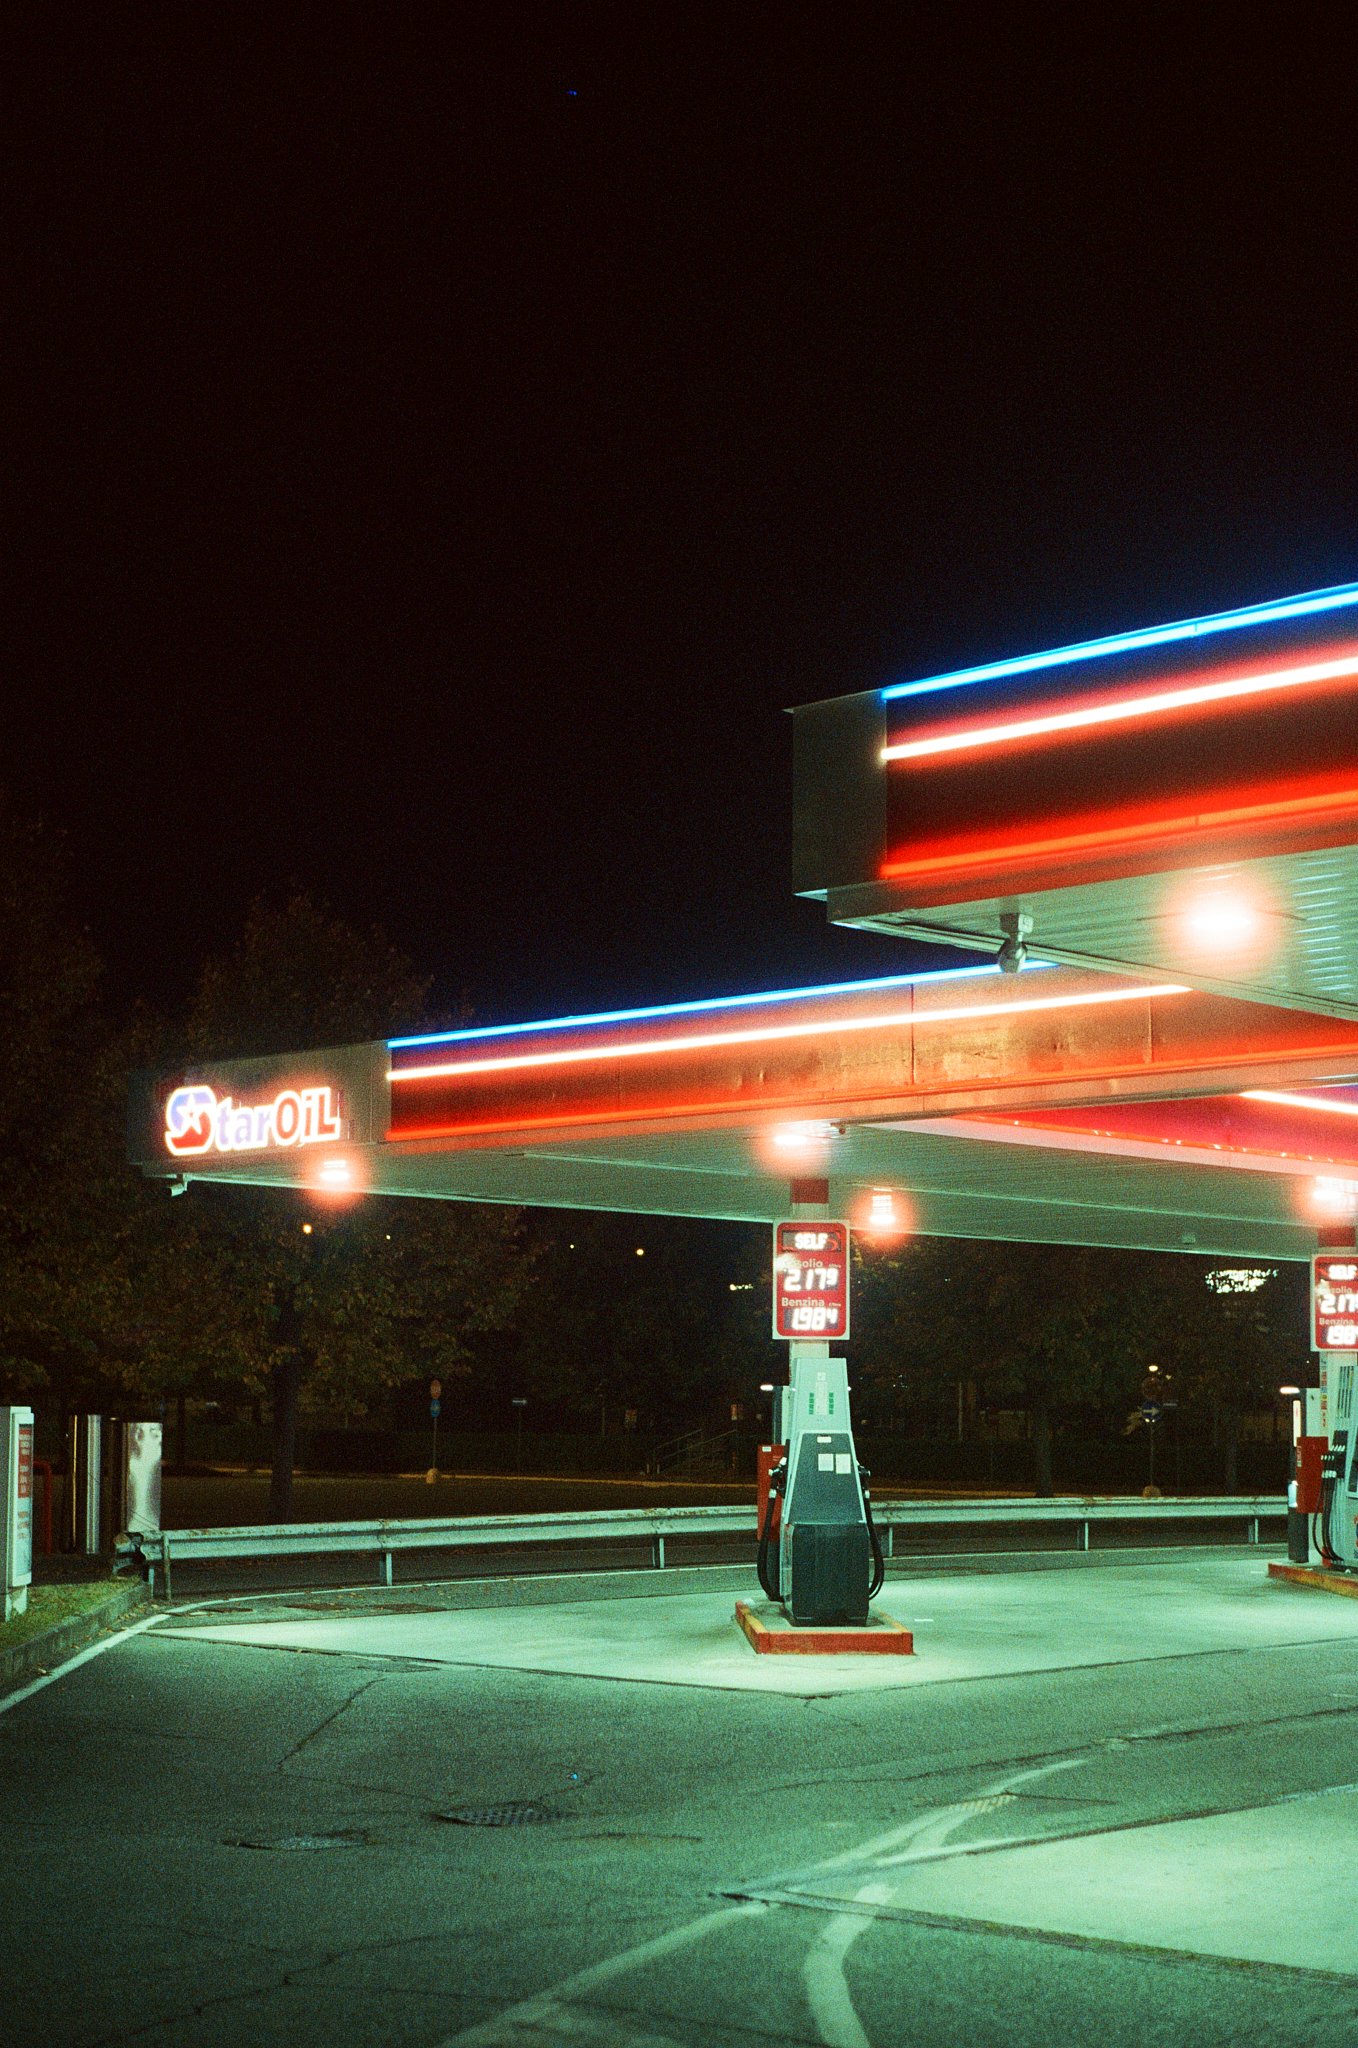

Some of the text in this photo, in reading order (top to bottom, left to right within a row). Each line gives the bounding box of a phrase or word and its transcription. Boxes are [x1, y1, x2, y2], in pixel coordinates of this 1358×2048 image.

[794, 1232, 828, 1250] SELF
[1328, 1264, 1357, 1280] SELF
[781, 1297, 825, 1307] Benzina
[1319, 1317, 1354, 1326] Benzina
